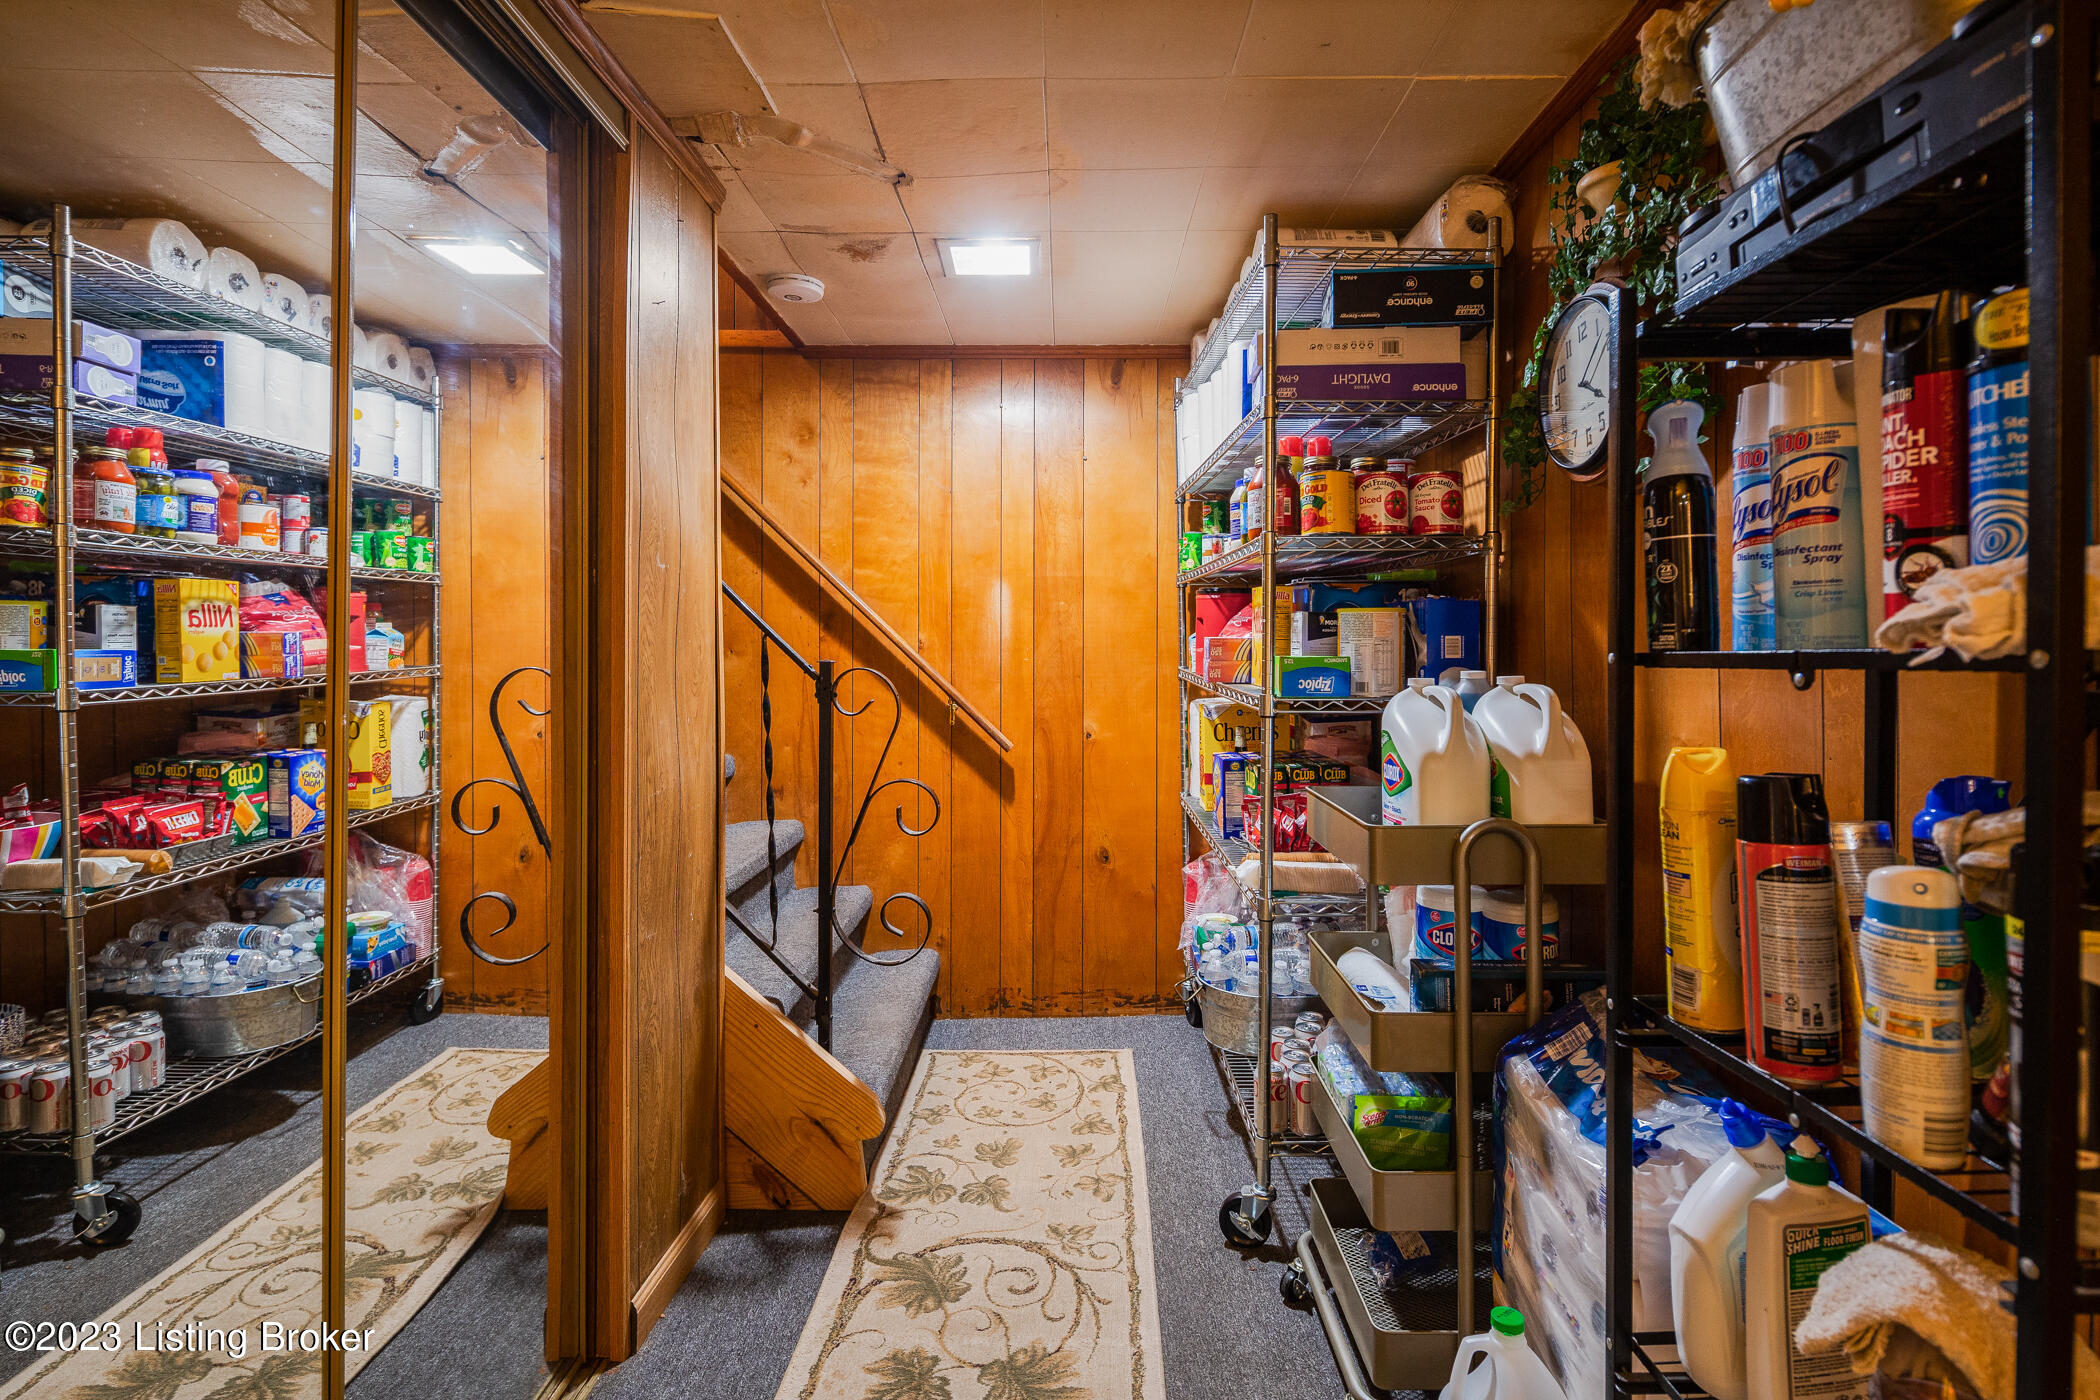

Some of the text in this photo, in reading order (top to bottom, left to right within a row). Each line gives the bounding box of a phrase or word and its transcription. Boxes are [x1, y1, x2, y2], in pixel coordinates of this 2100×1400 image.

[1387, 297, 1433, 306] enhance
[1578, 320, 1588, 344] 12
[1596, 318, 1600, 336] 1
[1566, 340, 1572, 360] 11
[1277, 374, 1299, 383] 6-PAC
[1332, 373, 1391, 384] DAYLIGHT
[1556, 364, 1566, 386] 10
[1413, 383, 1458, 392] enhance
[1598, 411, 1606, 432] 5
[1883, 412, 1910, 434] NT,
[2002, 416, 2028, 429] Ste
[1775, 432, 1808, 456] 100
[1883, 428, 1926, 453] ACH
[1737, 449, 1764, 469] 100
[1883, 446, 1939, 470] PIDER
[1361, 480, 1398, 492] Dei Fratelli
[1416, 478, 1454, 491] Dei Fratelli
[1883, 469, 1918, 488] LLER.
[1304, 484, 1328, 494] GOLD
[1360, 495, 1382, 504] Diced
[1733, 496, 1772, 540] Lyso
[1737, 551, 1773, 561] Disinfec
[1802, 554, 1843, 566] Spray
[1276, 592, 1290, 600] illa
[1298, 676, 1332, 692] Ziploc
[1274, 769, 1284, 781] UB
[1292, 769, 1315, 781] CLUB
[1324, 768, 1346, 780] CLUB
[1784, 859, 1822, 868] WEIMAN
[1432, 930, 1476, 947] CLOX
[1520, 943, 1559, 960] CROX
[1362, 1110, 1388, 1121] Scotch
[1787, 1226, 1820, 1242] QUICK
[1824, 1231, 1864, 1247] FLOOR FINISH
[1786, 1236, 1820, 1256] SHINE
